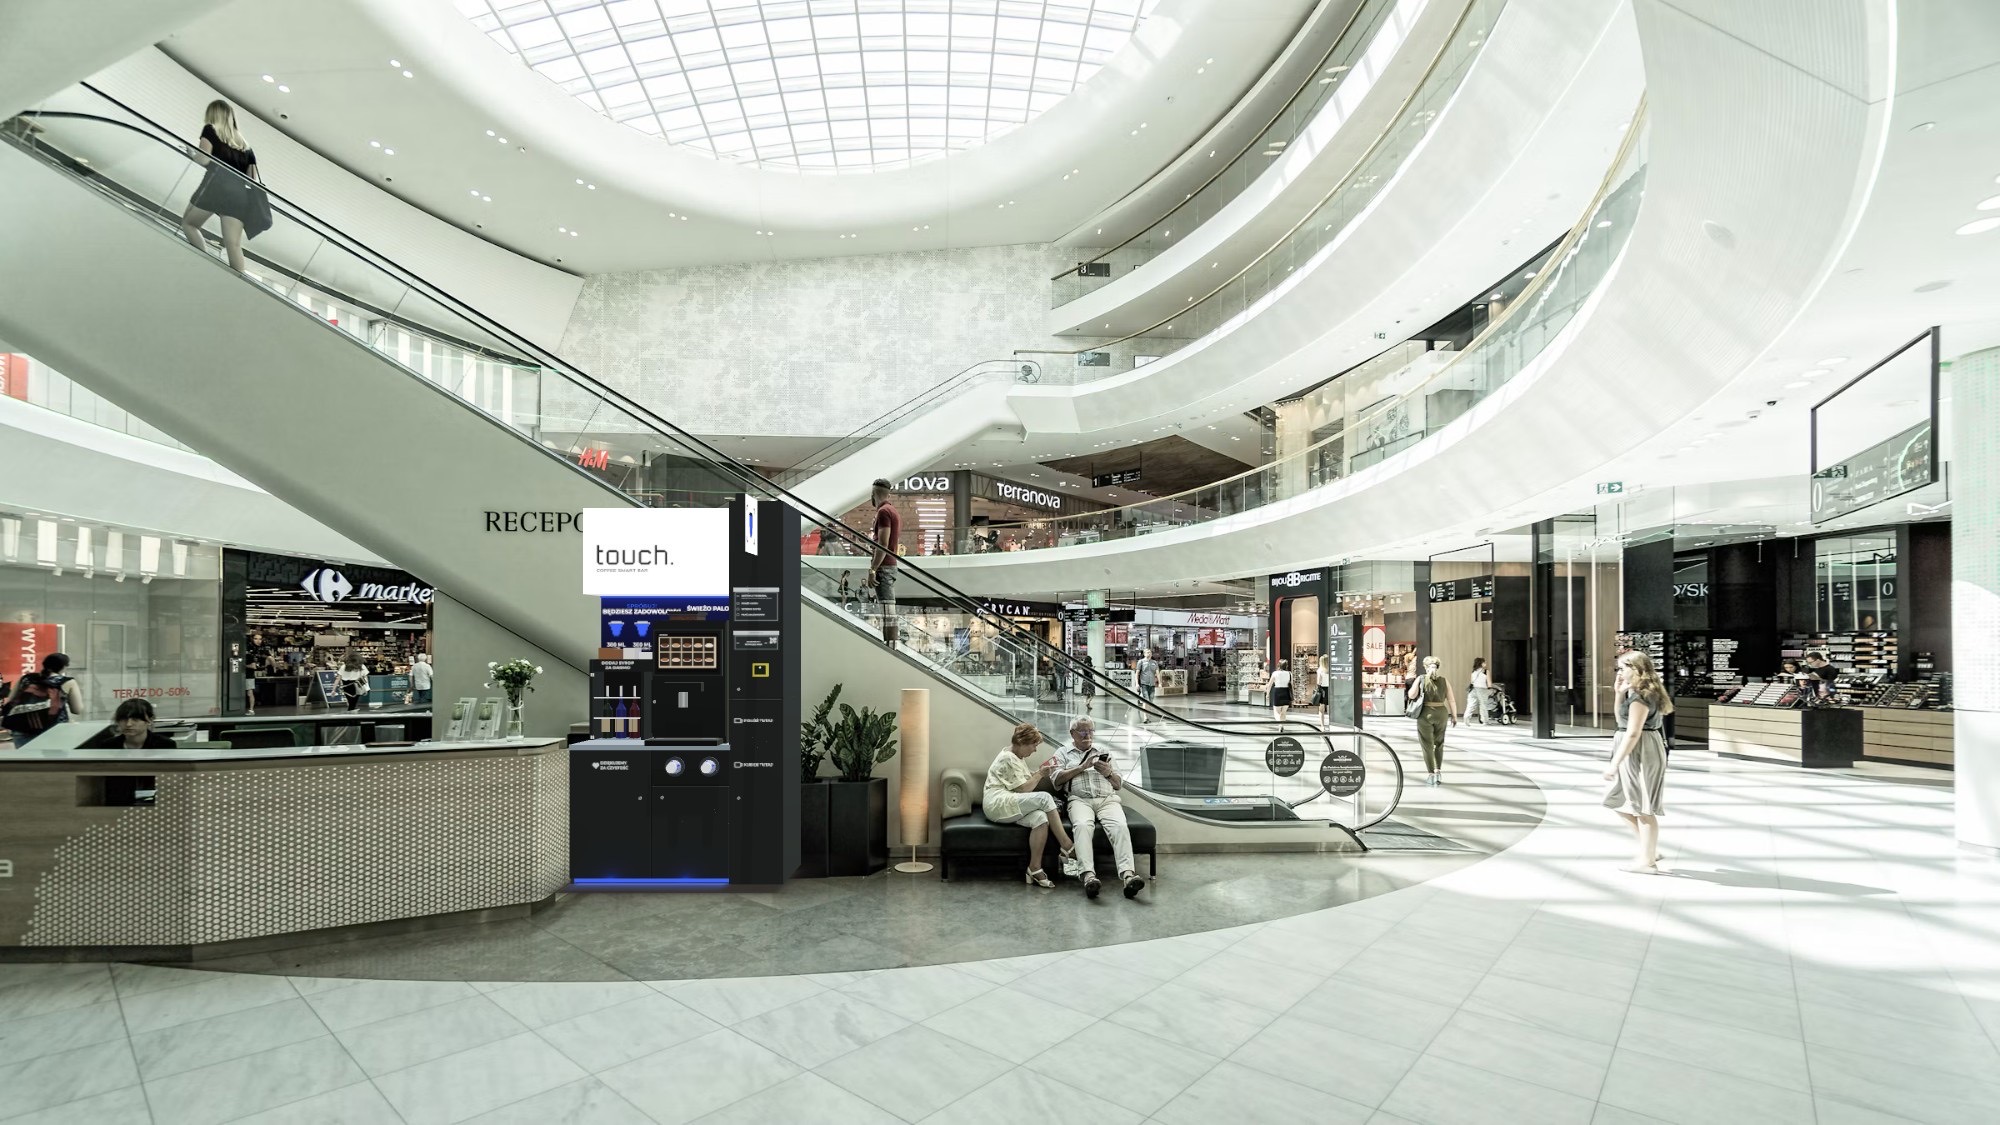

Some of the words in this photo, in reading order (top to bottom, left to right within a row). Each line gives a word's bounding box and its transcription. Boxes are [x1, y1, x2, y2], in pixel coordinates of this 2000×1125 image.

[578, 447, 608, 471] H&M
[1813, 482, 1822, 512] 0
[596, 544, 674, 565] touch.
[1429, 586, 1437, 600] 0
[686, 604, 711, 612] ŚWIEŻO
[1366, 642, 1383, 650] SALE
[113, 688, 147, 699] TERAZ
[148, 688, 163, 697] DO
[164, 687, 191, 697] -50%
